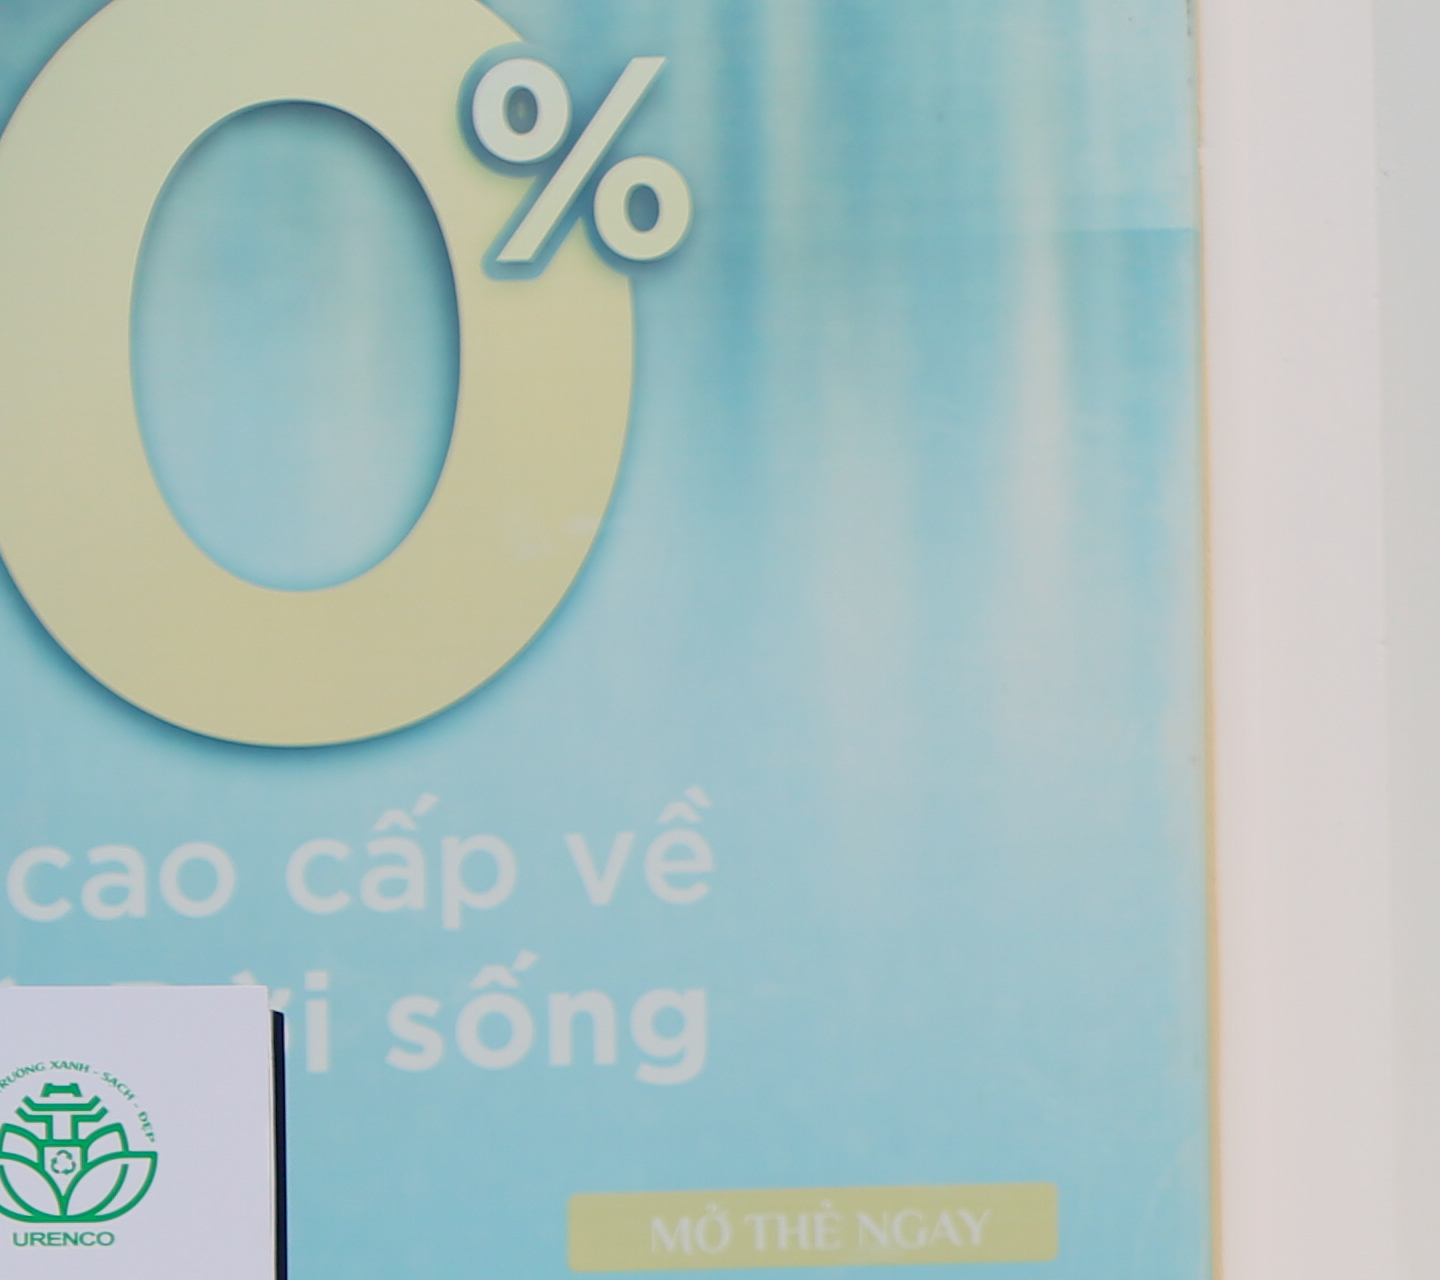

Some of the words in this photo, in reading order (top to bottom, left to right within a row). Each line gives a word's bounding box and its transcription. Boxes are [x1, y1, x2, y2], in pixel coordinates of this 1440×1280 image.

[6, 841, 236, 923] cao
[286, 793, 518, 931] cấp
[564, 785, 714, 906] về
[384, 950, 708, 1085] sống
[50, 1060, 90, 1074] XANH
[12, 1231, 116, 1247] URENCO
[651, 1203, 731, 1255] MỞ
[744, 1200, 840, 1251] THẺ
[857, 1207, 991, 1250] NGAY
